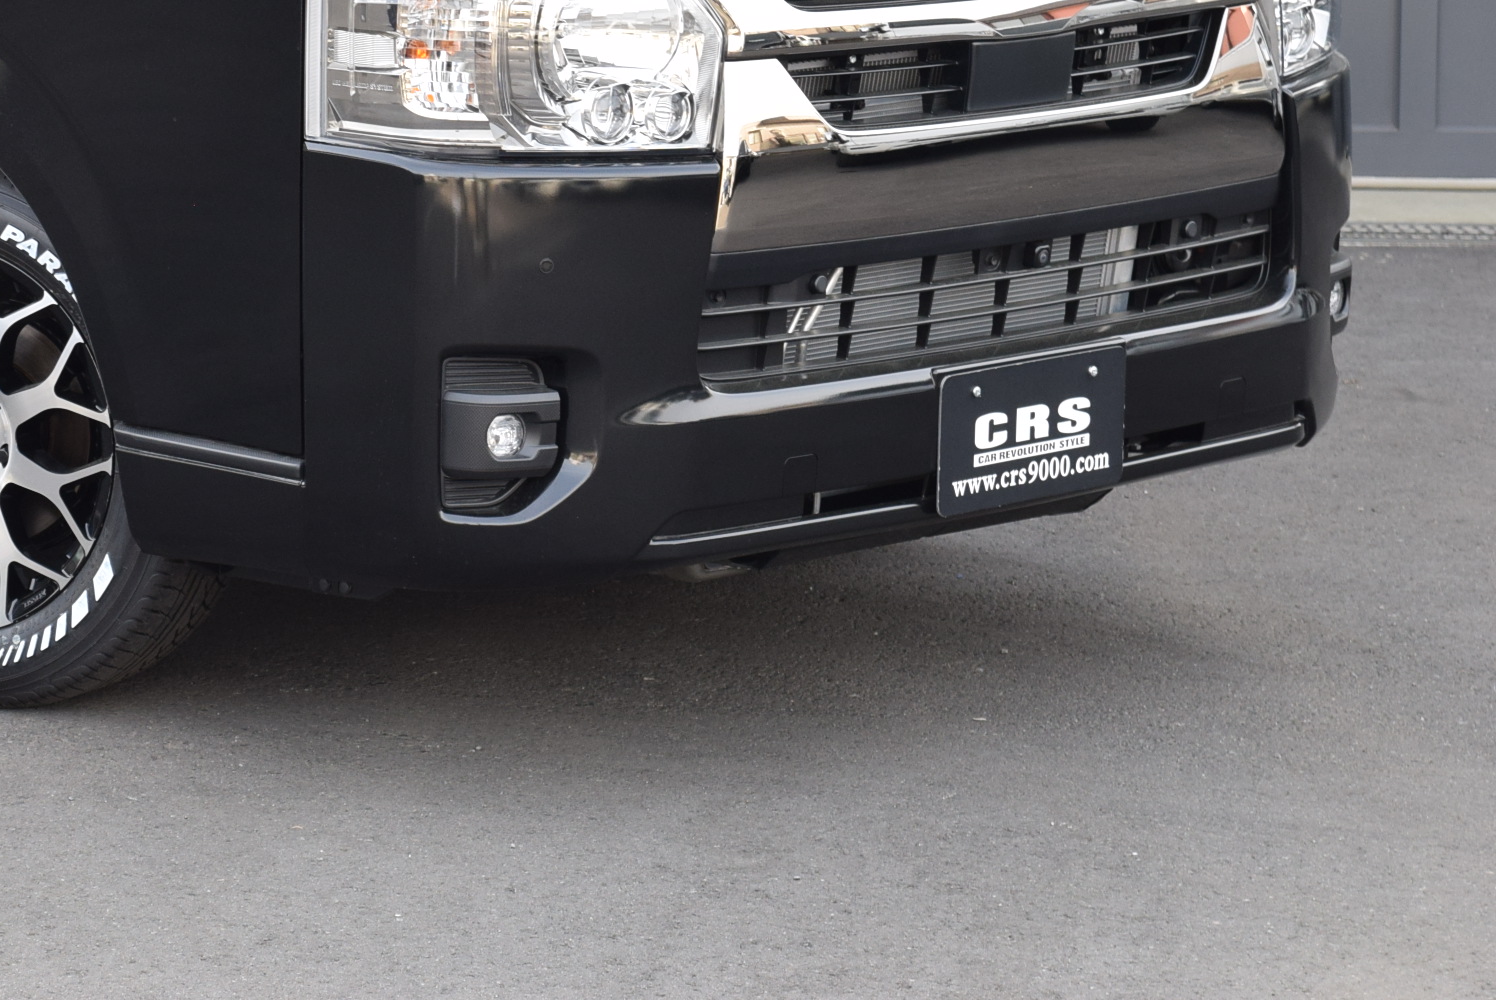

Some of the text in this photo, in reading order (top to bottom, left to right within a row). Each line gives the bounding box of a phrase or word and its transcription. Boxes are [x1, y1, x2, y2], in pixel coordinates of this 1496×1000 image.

[0, 224, 78, 302] PARA
[974, 397, 1091, 450] CRS
[952, 451, 1110, 498] www.crs9000.com
[978, 436, 1086, 464] CAR REVOLUTION STYLE
